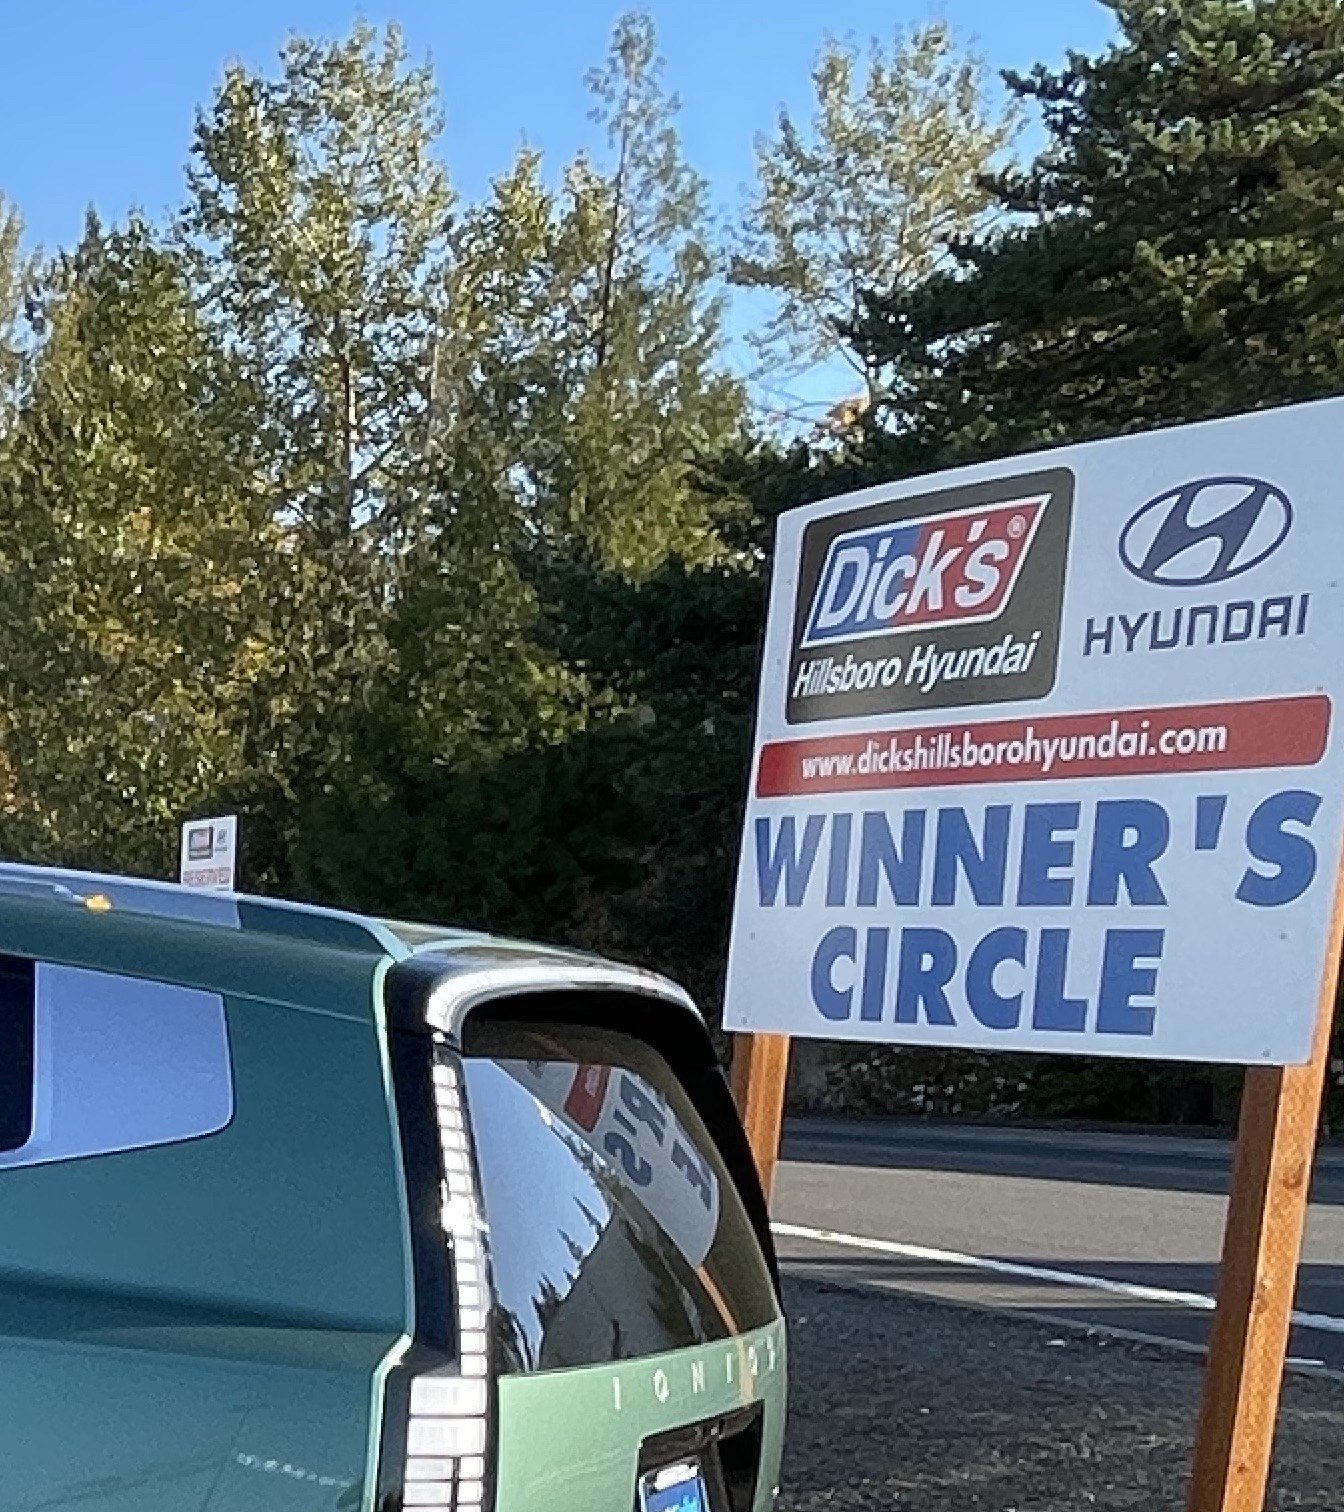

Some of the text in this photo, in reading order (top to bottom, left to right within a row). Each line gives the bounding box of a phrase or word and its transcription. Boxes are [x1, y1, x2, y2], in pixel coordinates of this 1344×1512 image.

[816, 518, 1010, 630] Dick's
[792, 630, 1042, 698] Hillsboro Hyundai
[1083, 592, 1310, 656] HYUNDAI
[801, 720, 1228, 779] www.dickshillsborohyundai.com
[755, 790, 1323, 907] WINNER'S
[811, 926, 1165, 1036] CIRCLE
